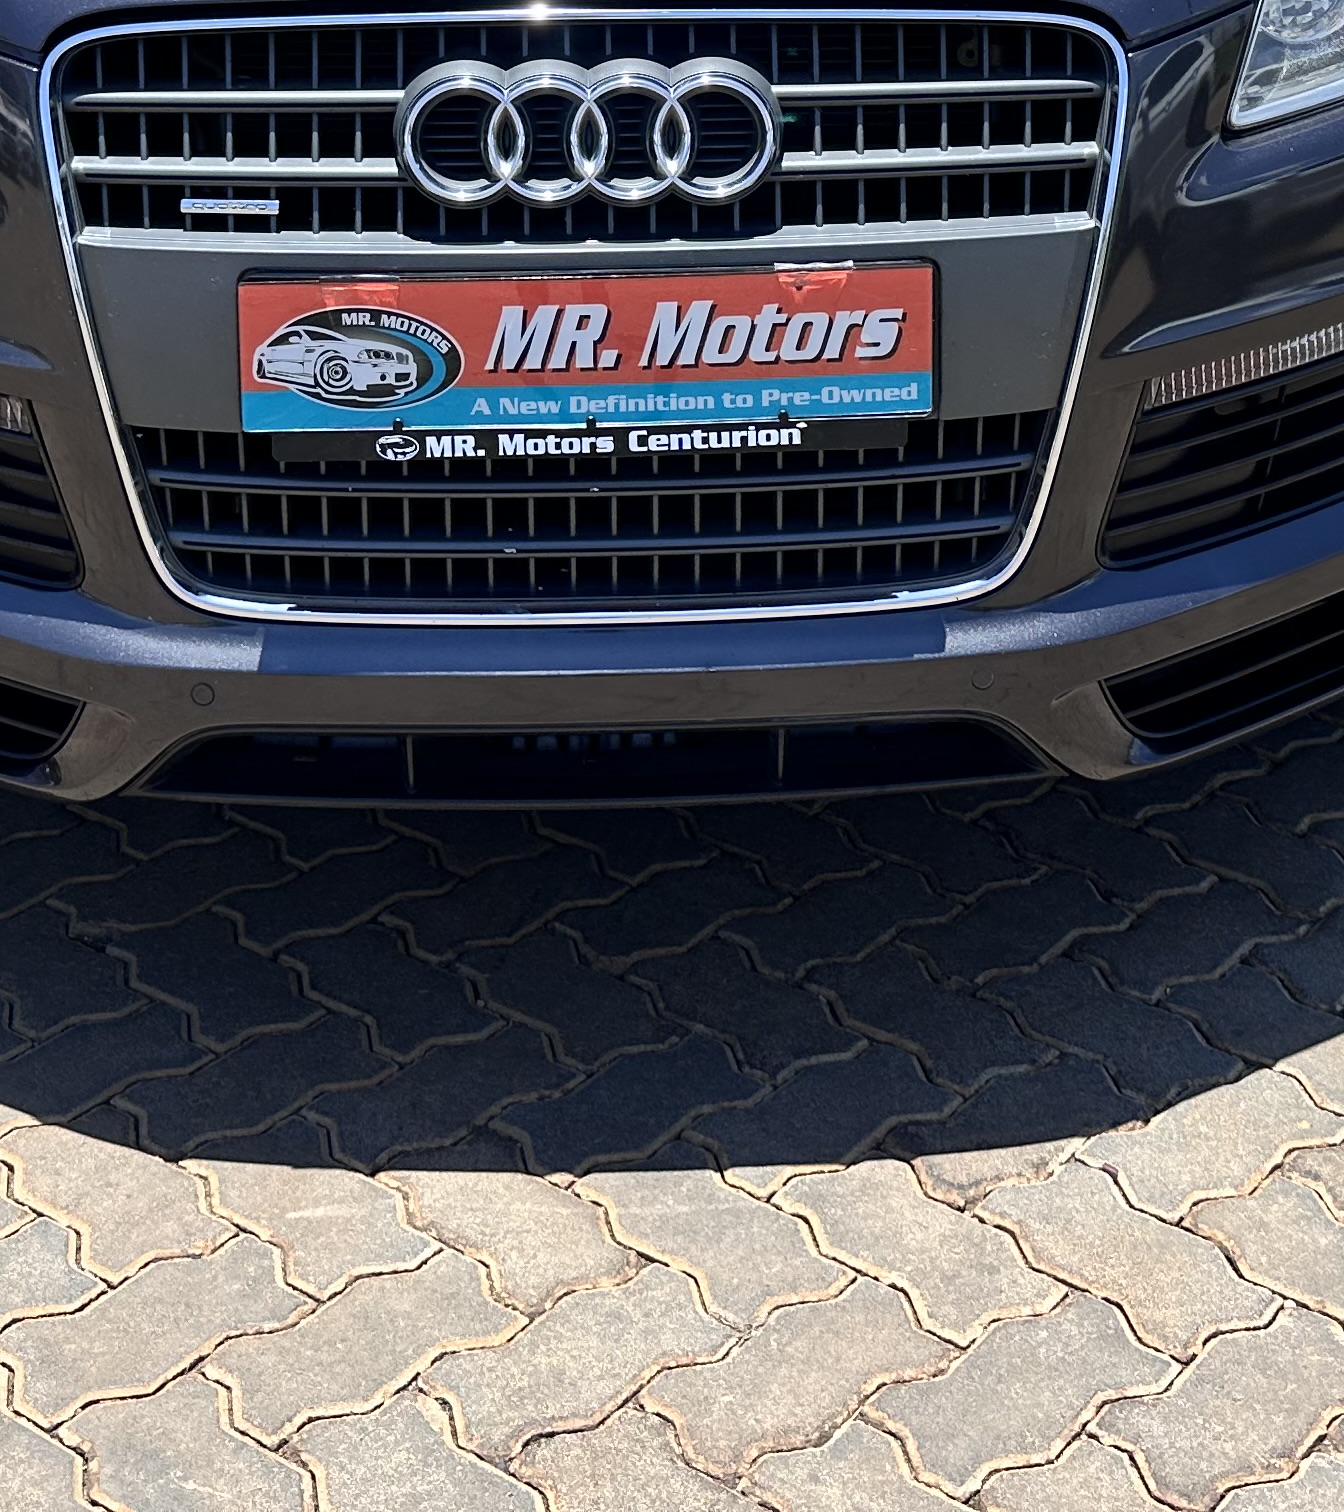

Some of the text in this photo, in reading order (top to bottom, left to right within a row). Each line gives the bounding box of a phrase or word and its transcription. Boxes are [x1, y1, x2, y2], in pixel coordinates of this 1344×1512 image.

[341, 312, 452, 354] MR. MOTORS
[484, 300, 905, 371] MR. Motors
[470, 382, 918, 416] A New Definition to Pre-Owned
[425, 424, 802, 458] MR. Motors Centurion
